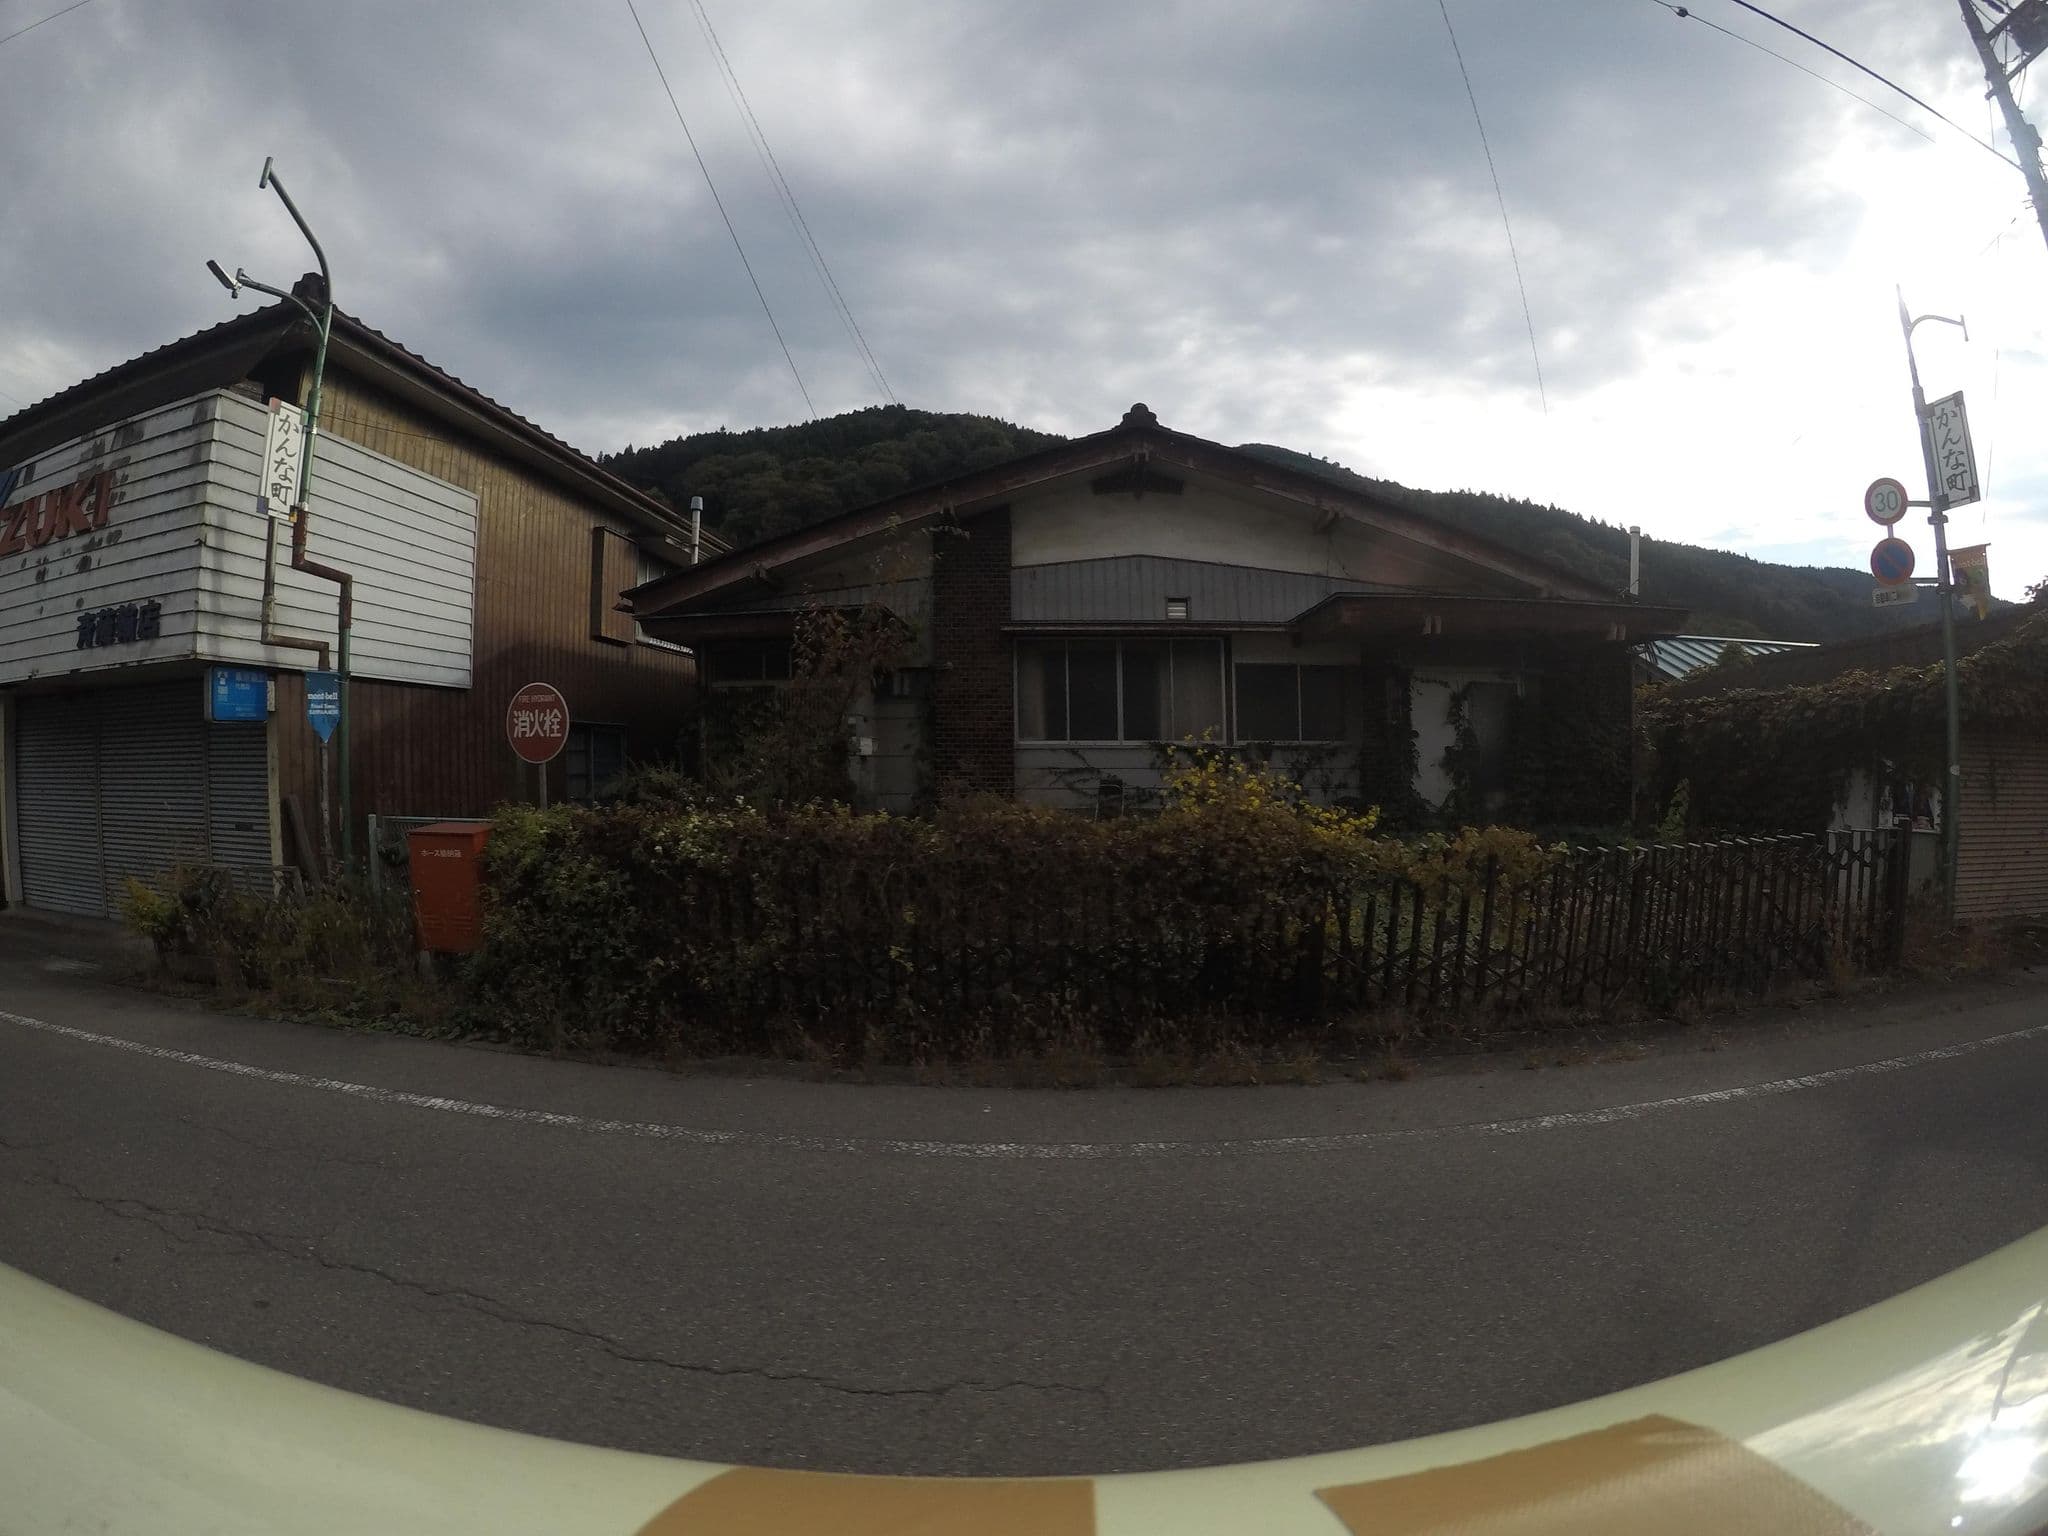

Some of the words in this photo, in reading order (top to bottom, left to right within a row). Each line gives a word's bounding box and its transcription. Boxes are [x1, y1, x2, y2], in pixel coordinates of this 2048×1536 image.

[271, 414, 300, 506] かんな町
[1936, 407, 1968, 491] かんな町
[1875, 490, 1899, 512] 30
[513, 709, 562, 737] 消火栓
